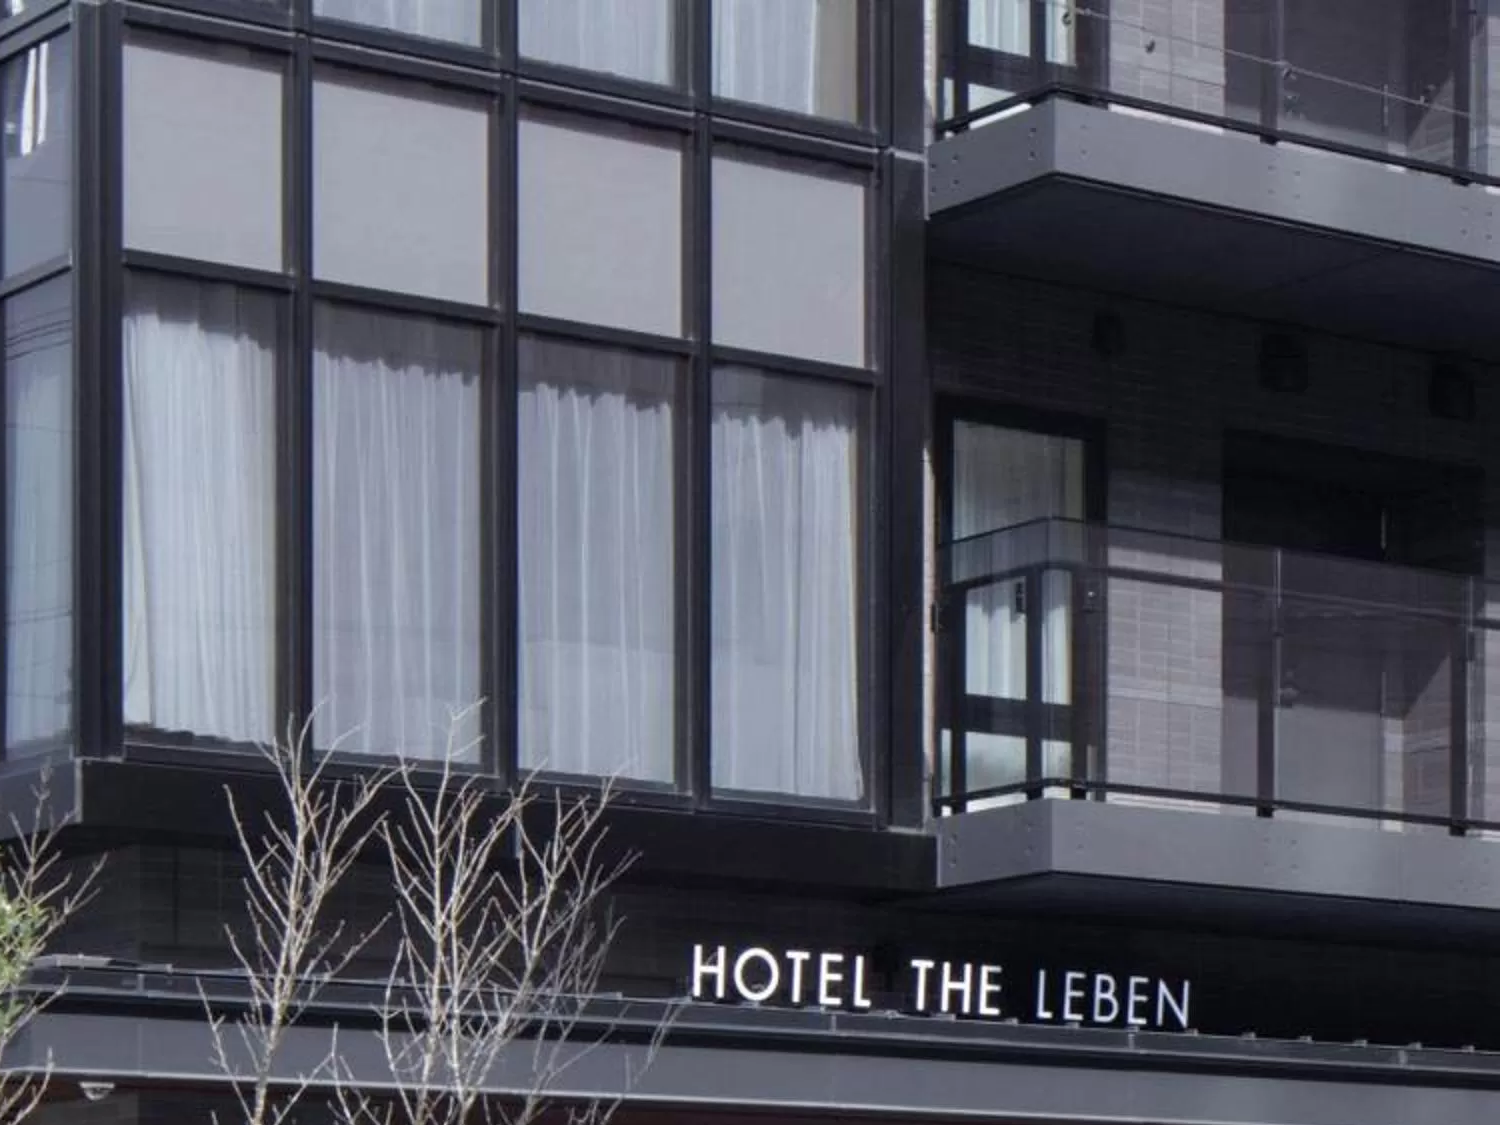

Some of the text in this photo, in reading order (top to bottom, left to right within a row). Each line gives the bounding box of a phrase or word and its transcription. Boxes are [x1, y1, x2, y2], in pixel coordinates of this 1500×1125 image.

[692, 944, 1191, 1029] HOTEL THE LEBEN
